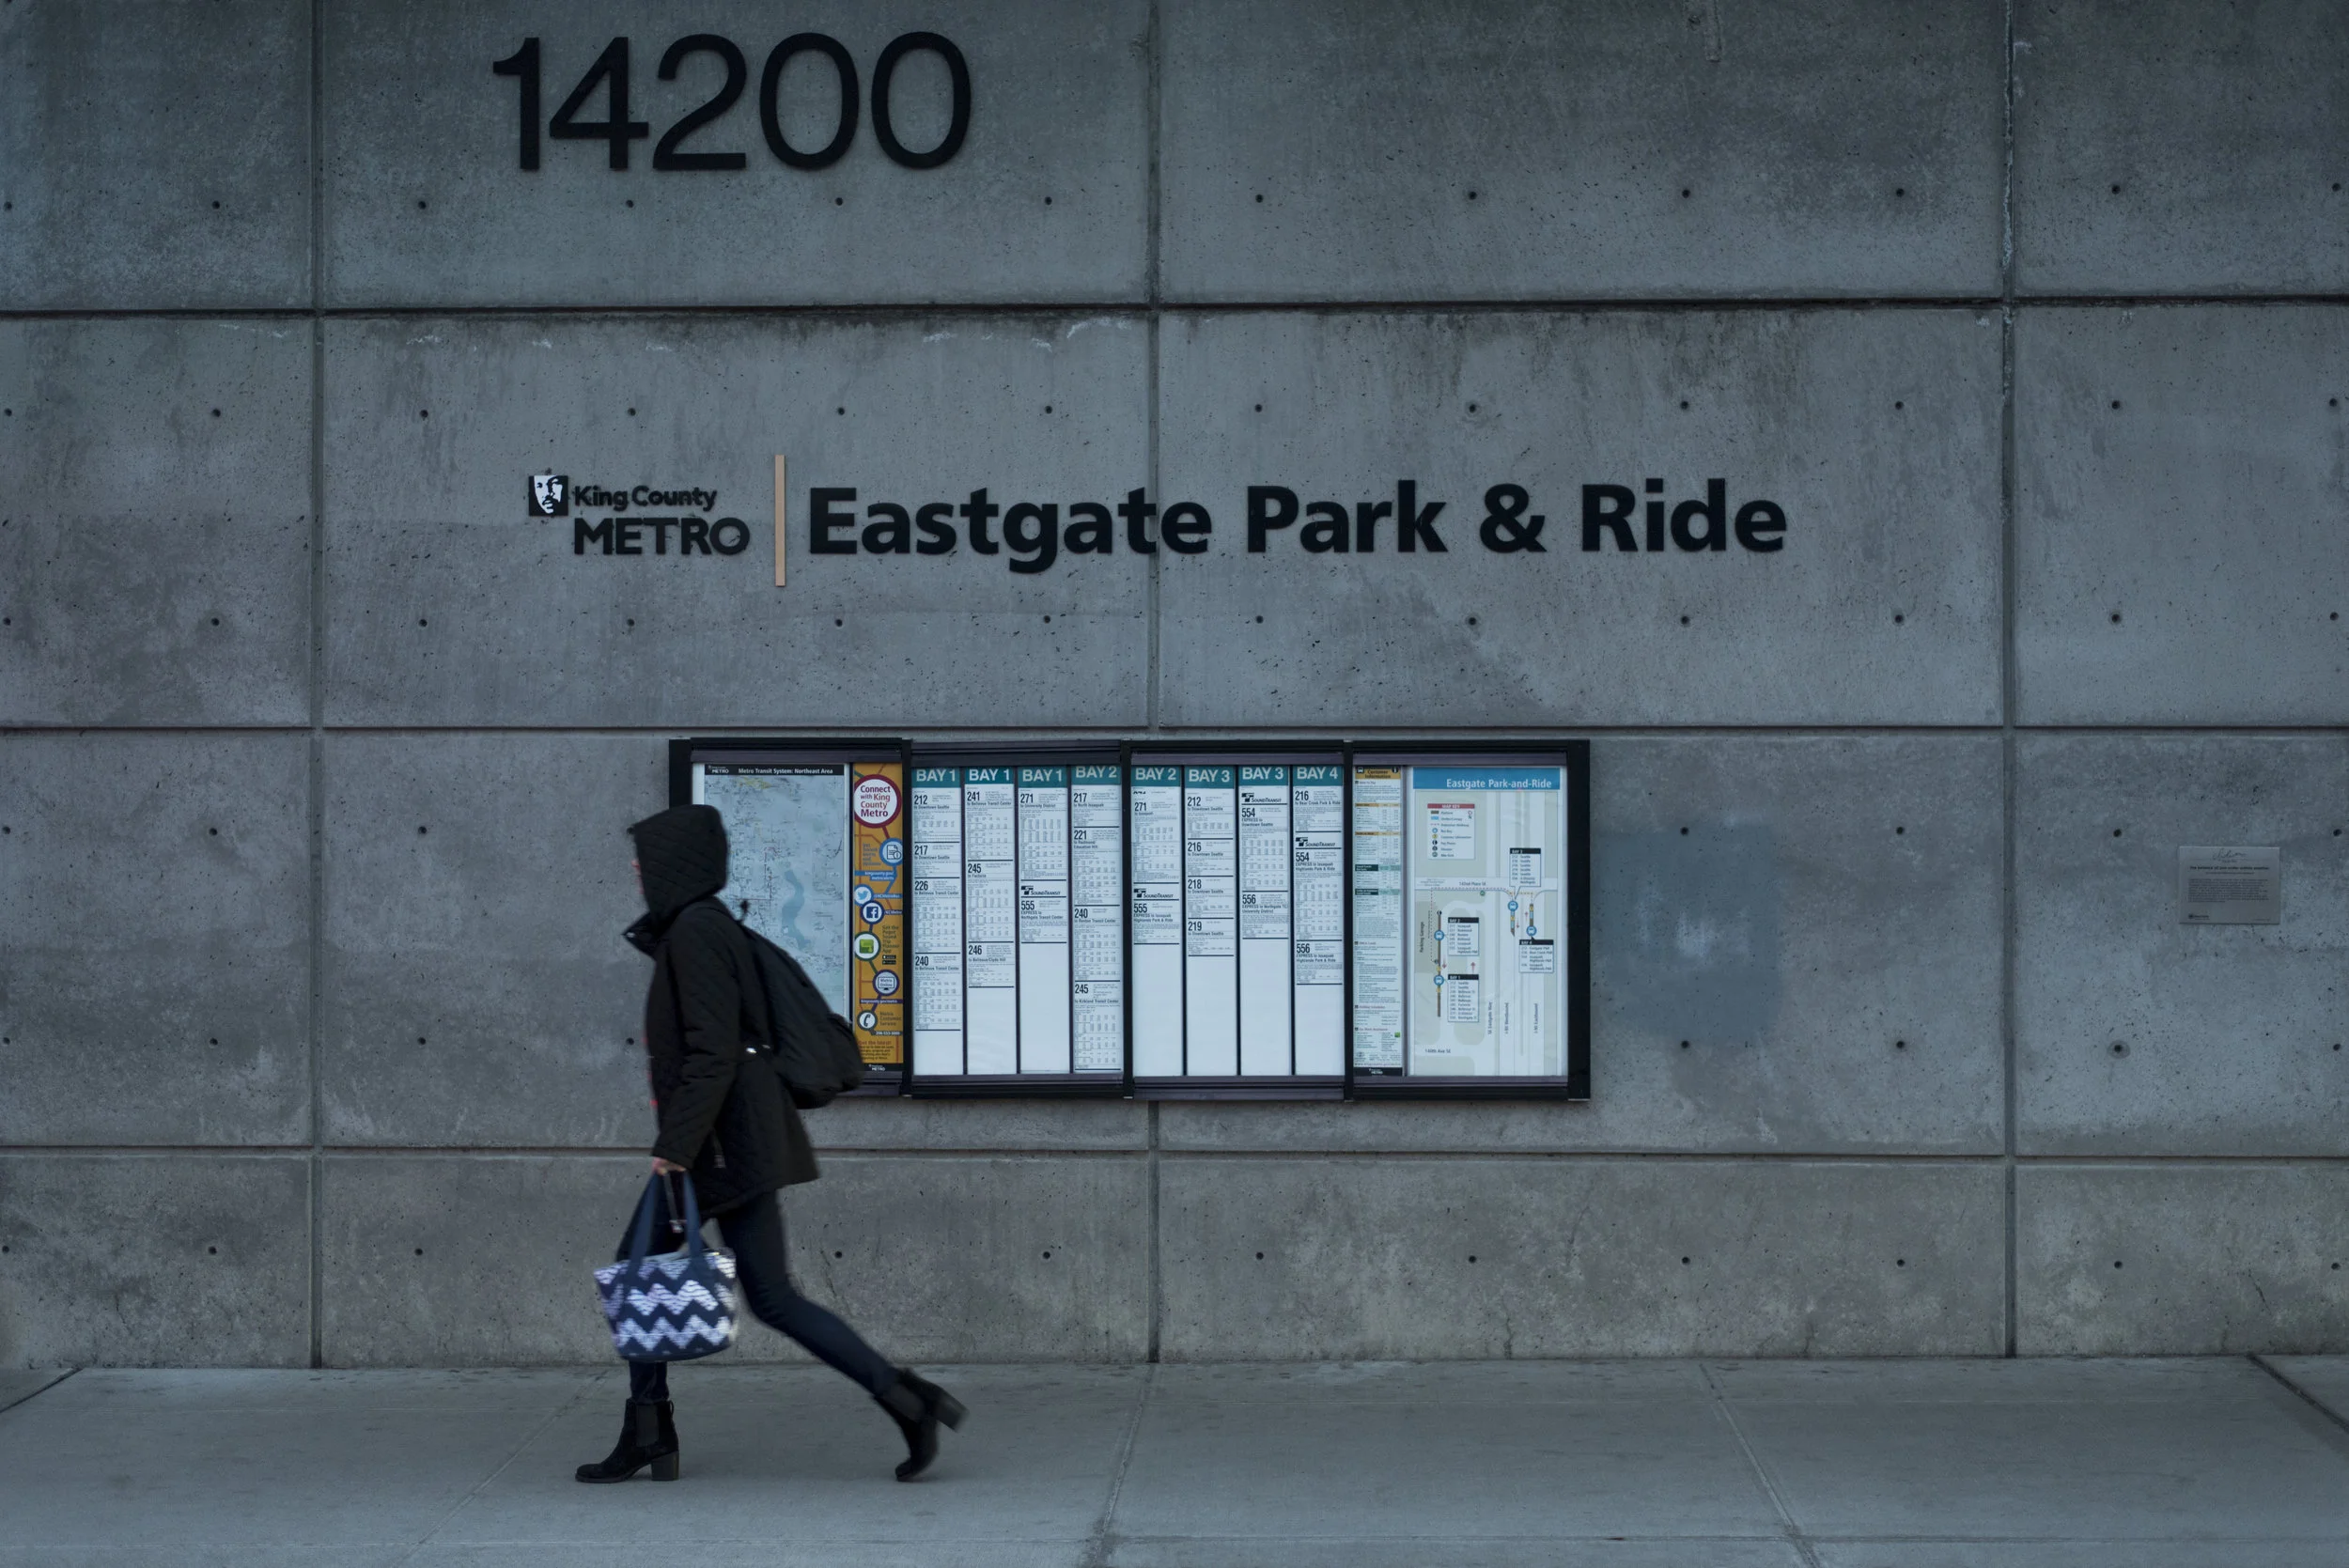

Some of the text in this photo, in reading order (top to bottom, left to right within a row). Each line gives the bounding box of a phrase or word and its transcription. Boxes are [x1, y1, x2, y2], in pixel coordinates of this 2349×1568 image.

[492, 31, 972, 170] 14200
[574, 486, 718, 511] King County
[809, 477, 1787, 574] Eastgate Park & Ride
[574, 517, 751, 555] METRO
[916, 769, 956, 782] BAY 1
[969, 768, 1010, 782] BAY 1
[1022, 769, 1062, 782] BAY 1
[1076, 766, 1117, 778] BAY 2
[1135, 768, 1176, 780] BAY 2
[1189, 769, 1230, 782] BAY 3
[1242, 767, 1283, 780] BAY 3
[1297, 767, 1338, 780] BAY 4
[1446, 779, 1552, 789] Eastgate Park-and-Ride
[874, 793, 891, 802] King
[914, 795, 927, 805] 212
[967, 791, 980, 801] 241
[1020, 793, 1034, 803] 271
[1074, 793, 1087, 802] 217
[1295, 791, 1309, 800] 216
[861, 800, 887, 810] County
[1188, 797, 1201, 806] 212
[1134, 802, 1146, 812] 271
[861, 809, 888, 817] Metro
[1242, 808, 1255, 817] 554
[1074, 830, 1087, 840] 221
[914, 846, 928, 855] 217
[1188, 842, 1201, 852] 216
[1296, 852, 1309, 862] 554
[968, 863, 981, 874] 245
[915, 880, 928, 891] 226
[1188, 879, 1201, 889] 218
[1242, 894, 1256, 904] 556
[1020, 900, 1034, 910] 555
[1133, 903, 1147, 913] 555
[1075, 908, 1088, 919] 240
[1188, 921, 1202, 931] 219
[968, 945, 982, 955] 246
[1297, 943, 1310, 953] 556
[915, 955, 928, 966] 240
[1075, 984, 1089, 994] 245
